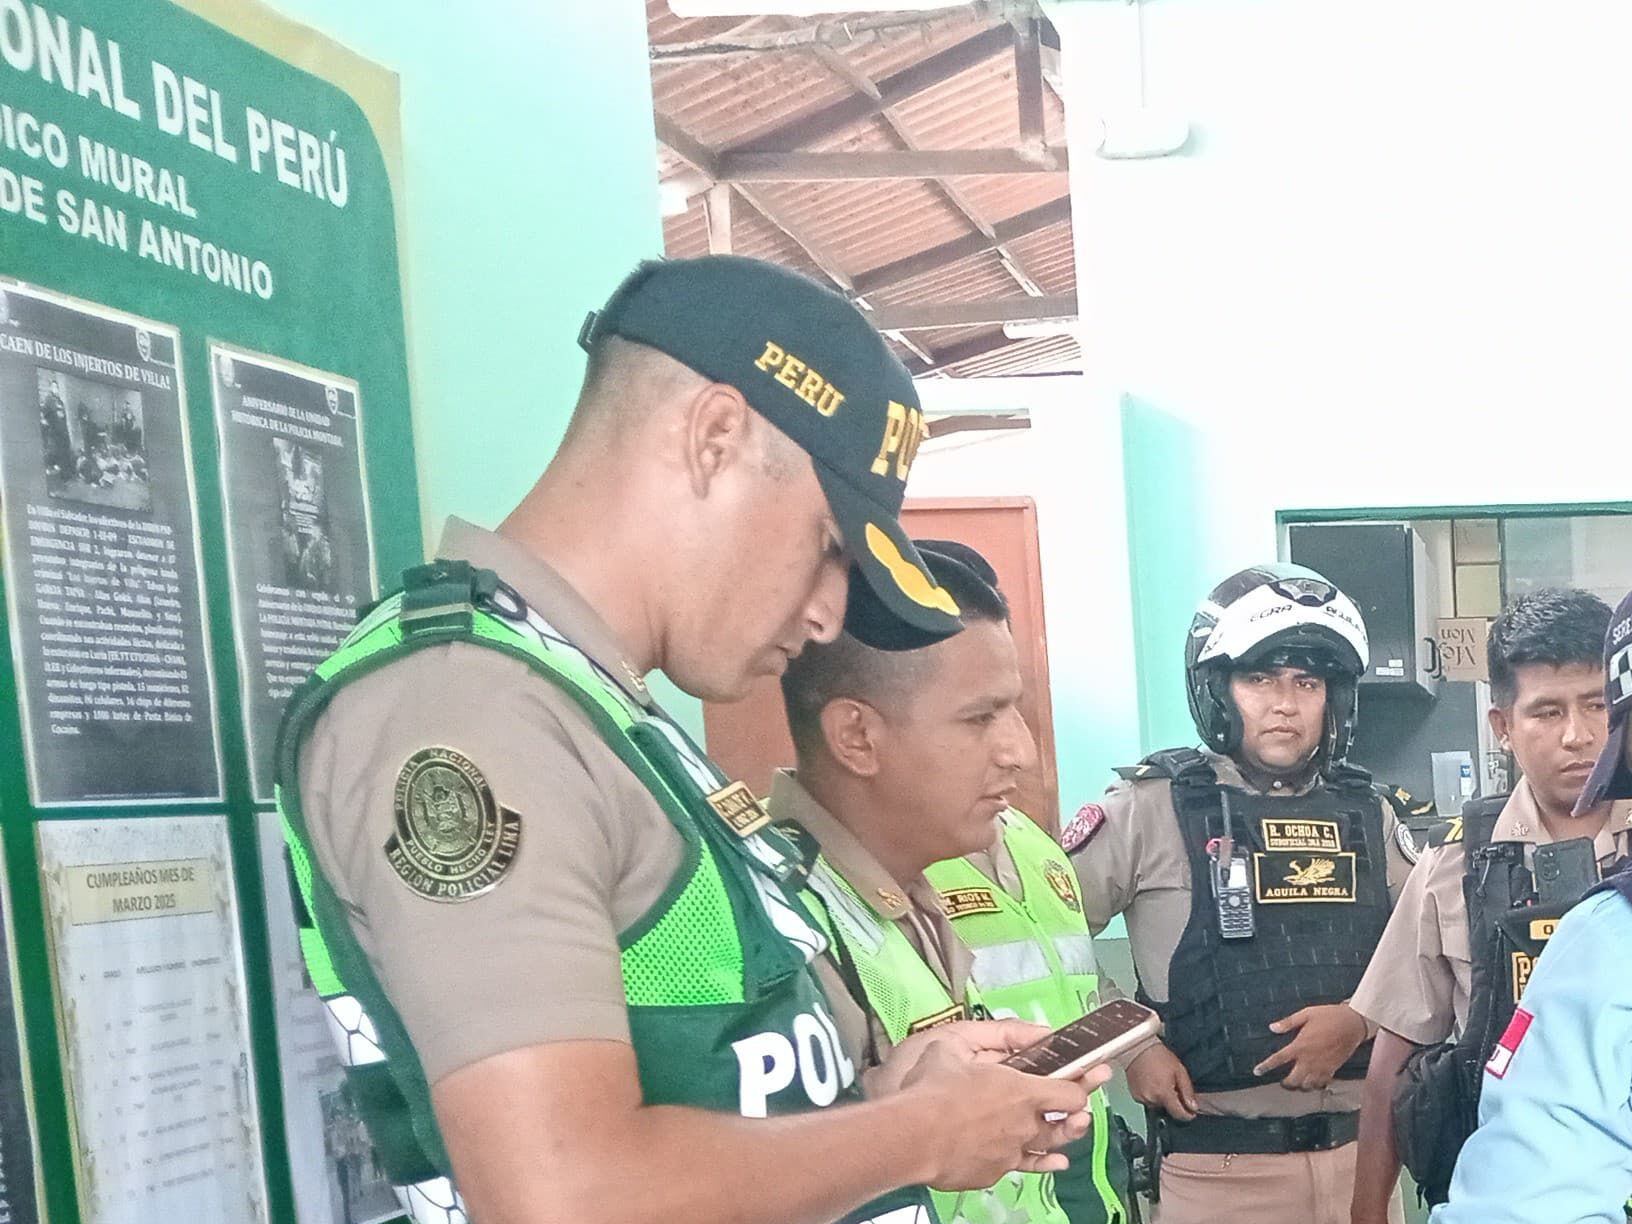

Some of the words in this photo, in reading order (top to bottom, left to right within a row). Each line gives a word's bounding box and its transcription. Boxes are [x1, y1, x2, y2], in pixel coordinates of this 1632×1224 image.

[0, 104, 69, 168] ICO
[79, 134, 197, 218] MURAL
[152, 60, 237, 163] DEL
[246, 106, 348, 209] PERÚ
[0, 167, 48, 224] DE
[56, 189, 127, 252] SAN
[139, 219, 273, 300] ANTONIO
[754, 340, 846, 417] PERU
[870, 400, 930, 481] PO
[389, 849, 434, 891] REGION
[437, 860, 506, 896] POLICIAL
[503, 822, 519, 858] LIMA
[1284, 825, 1320, 838] OCHOA
[87, 867, 157, 889] CUMPLEAÑOS
[159, 868, 180, 883] MES
[182, 866, 195, 882] DE
[112, 896, 152, 913] MARZO
[1266, 887, 1308, 897] AGUILA
[1313, 887, 1348, 896] NEGRA
